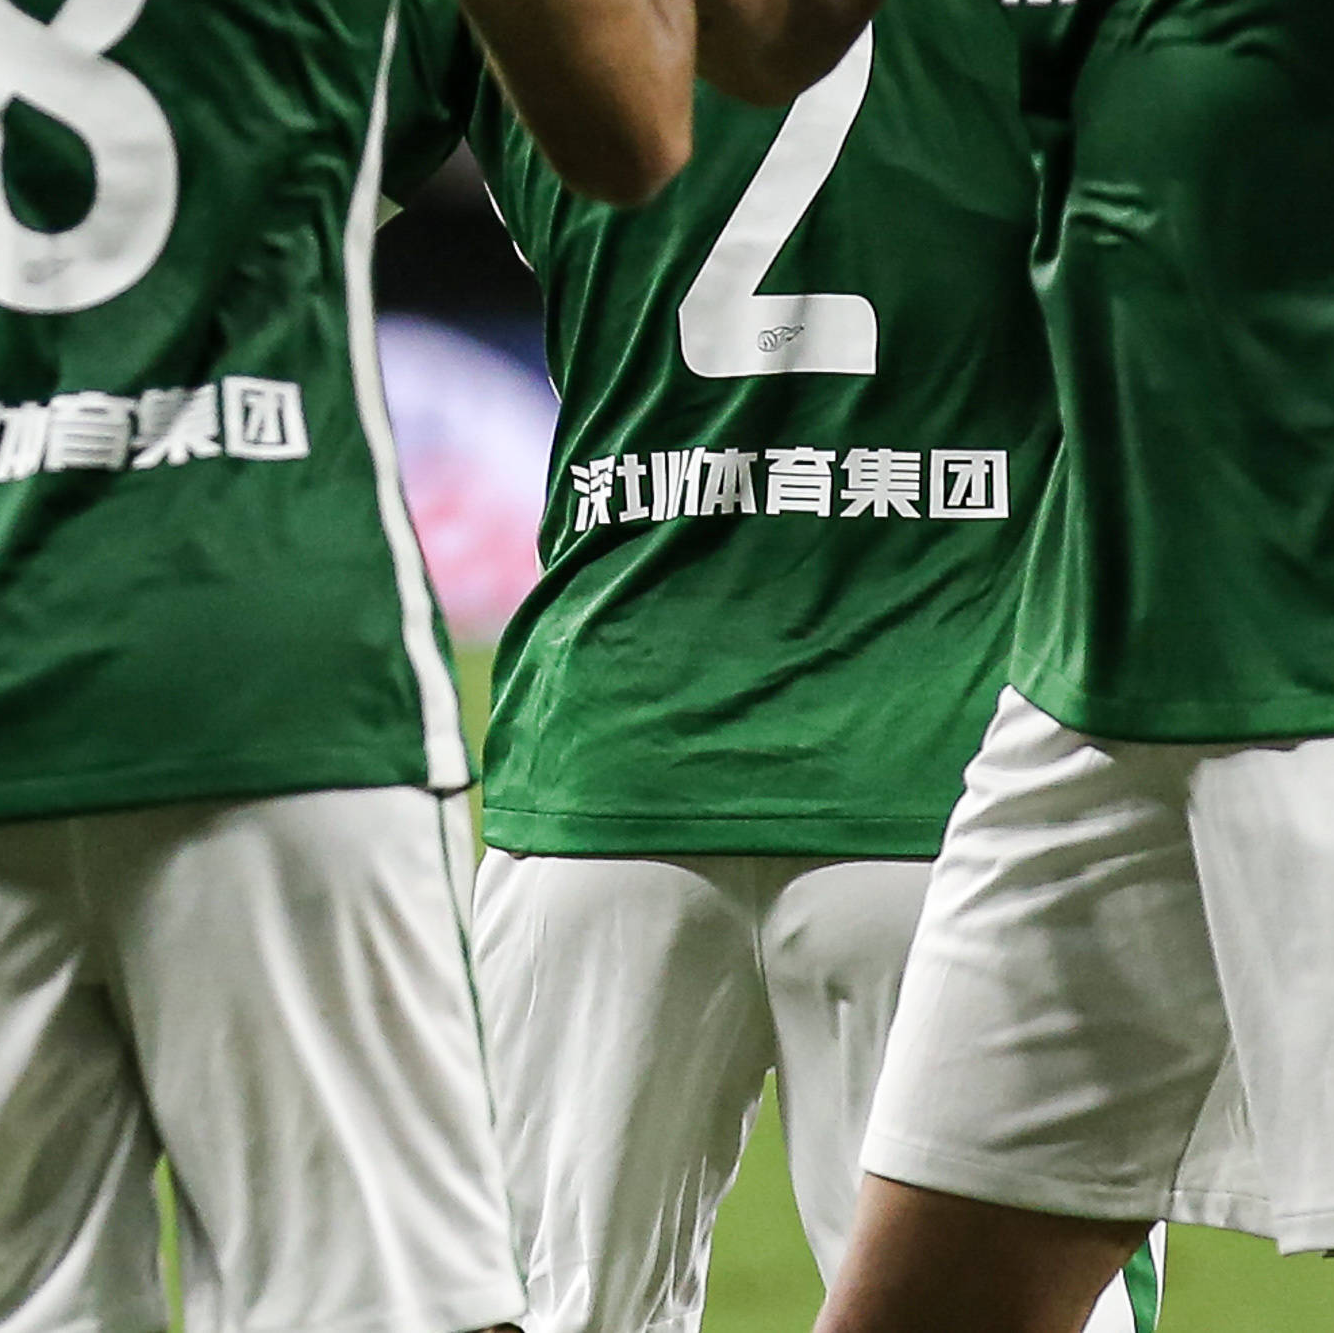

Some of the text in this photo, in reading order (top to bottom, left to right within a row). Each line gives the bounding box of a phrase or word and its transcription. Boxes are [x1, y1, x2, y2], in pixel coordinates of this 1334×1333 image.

[678, 18, 879, 379] 2
[569, 446, 1010, 533] 深圳体育集团
